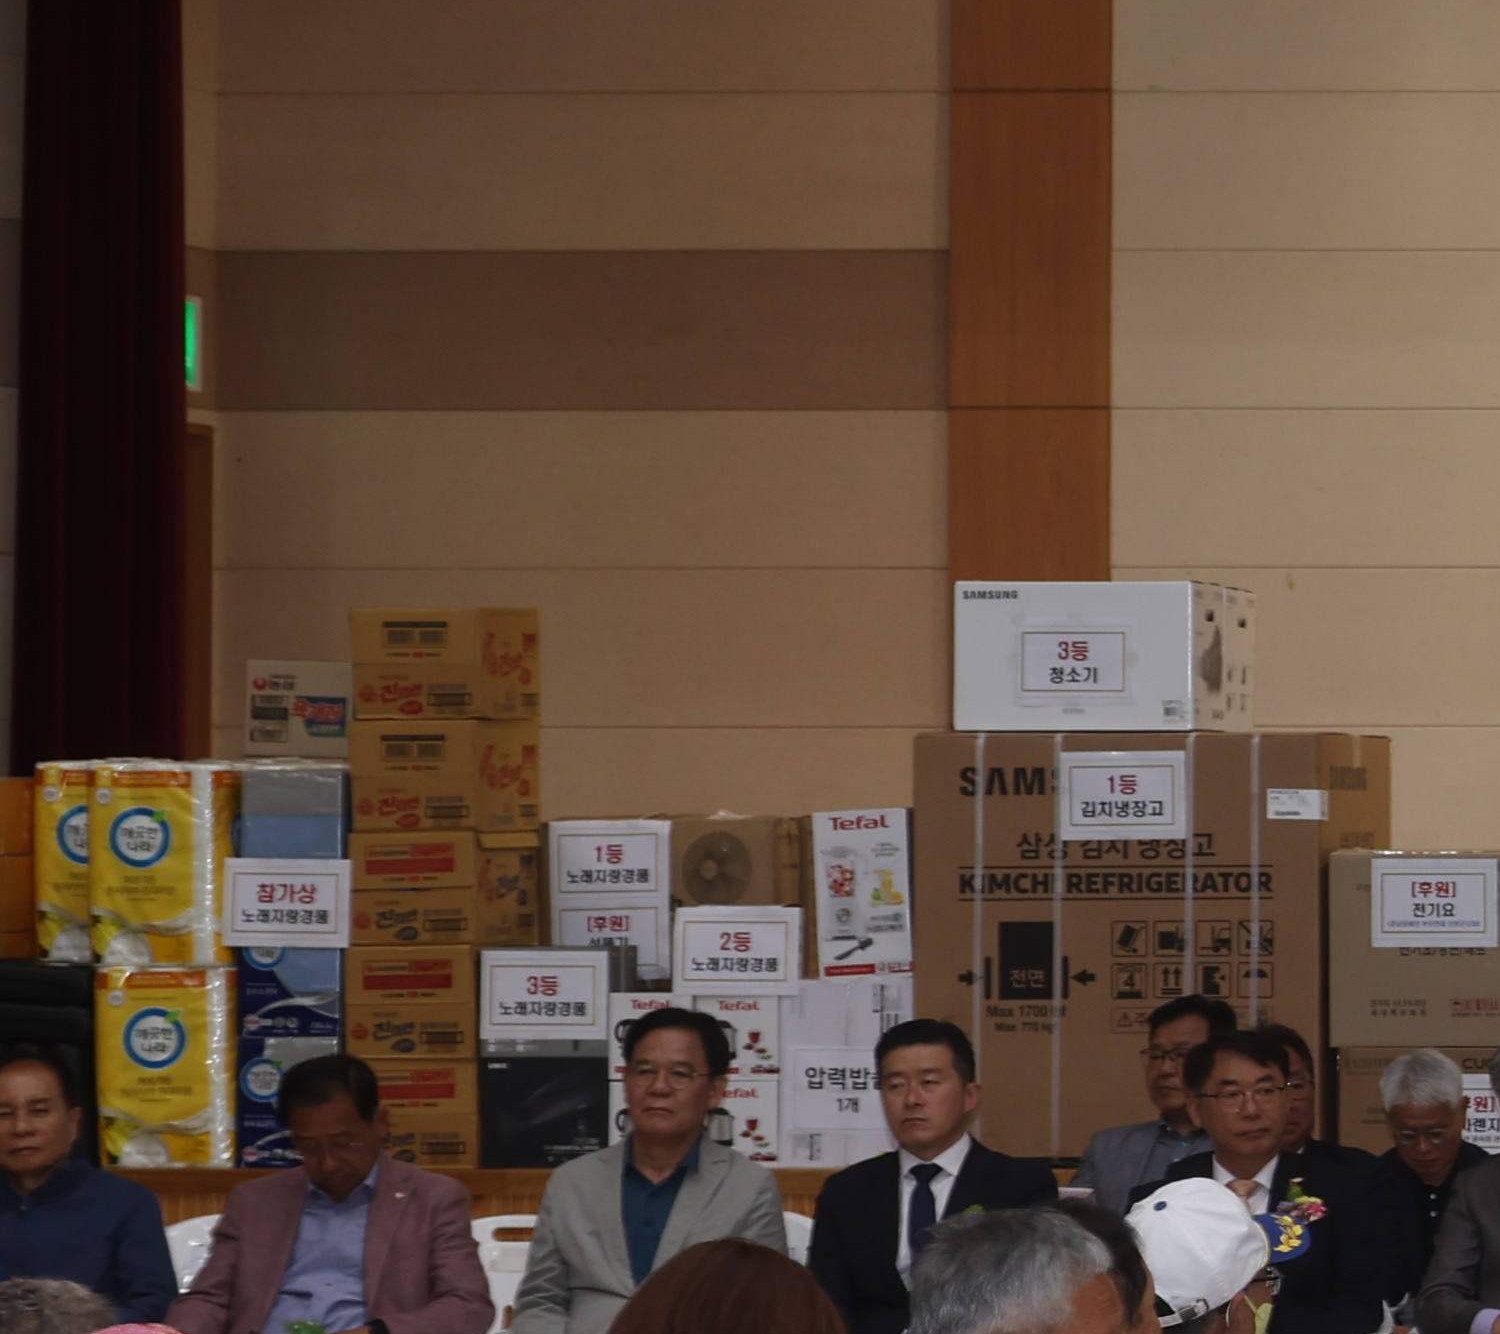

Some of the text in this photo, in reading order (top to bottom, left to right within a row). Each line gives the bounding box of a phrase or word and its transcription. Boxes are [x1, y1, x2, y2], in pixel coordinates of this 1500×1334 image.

[962, 589, 1019, 600] SAMSUNG
[1057, 640, 1089, 662] 3등
[1048, 666, 1098, 685] 청소기
[1106, 774, 1138, 796] 1등
[1080, 800, 1165, 818] 김치냉장고
[828, 814, 891, 831] Tefal
[594, 844, 624, 865] 1등
[566, 868, 650, 885] 노래자랑경품
[1066, 872, 1274, 894] REFRIGERATOR
[256, 883, 318, 904] 참가상
[1410, 881, 1457, 899] [후원]
[241, 908, 329, 925] 노래자랑경품
[1411, 903, 1456, 918] 전기요
[719, 932, 753, 952] 2등
[691, 956, 779, 974] 노래자랑경품
[526, 976, 561, 997] 3등
[1008, 969, 1045, 989] 전면
[499, 1001, 586, 1017] 노래자랑경품
[718, 999, 759, 1011] Tefal
[986, 1005, 1014, 1017] Max
[722, 1088, 758, 1099] efal
[836, 1096, 859, 1114] 1개
